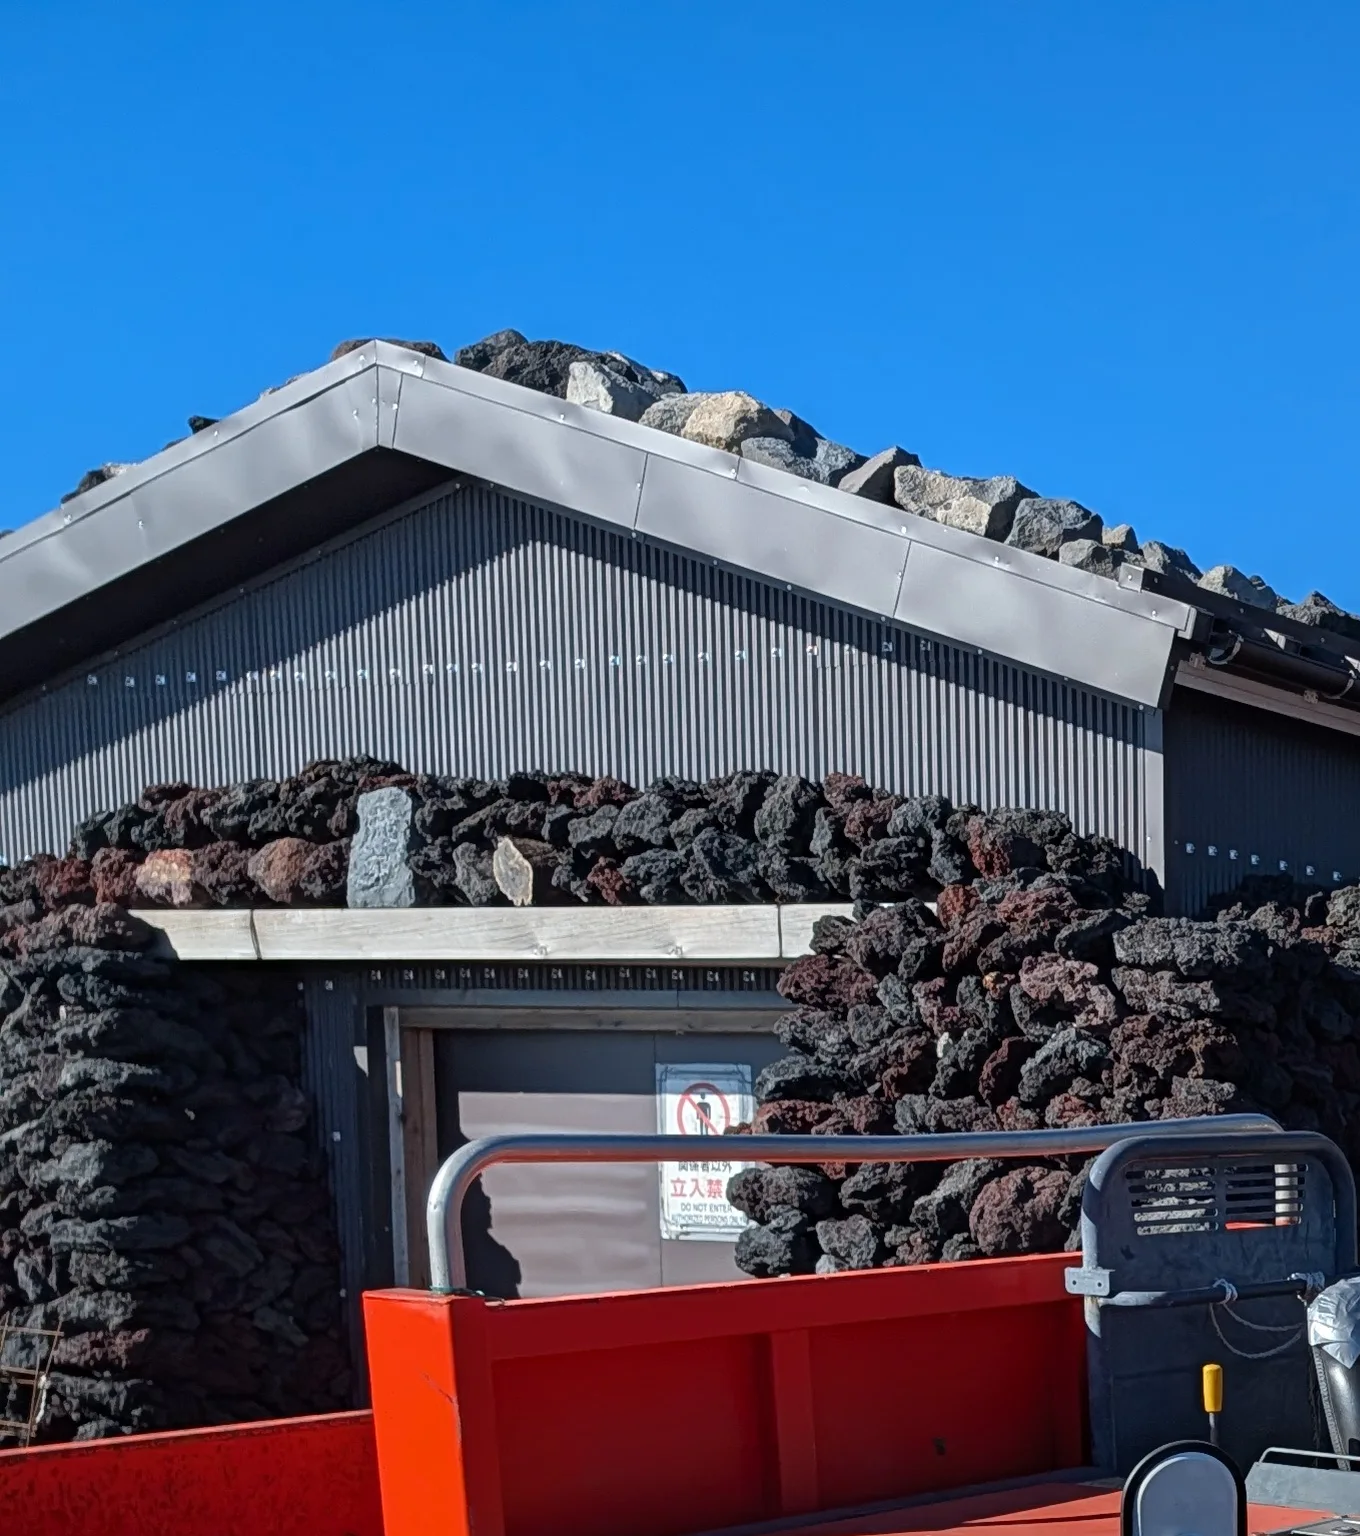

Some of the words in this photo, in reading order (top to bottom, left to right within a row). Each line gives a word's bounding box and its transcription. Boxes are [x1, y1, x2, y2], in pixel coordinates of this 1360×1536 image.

[670, 1178, 723, 1199] 立入禁
[680, 1202, 692, 1212] DO
[693, 1203, 708, 1213] NOT
[709, 1203, 733, 1214] ENTER
